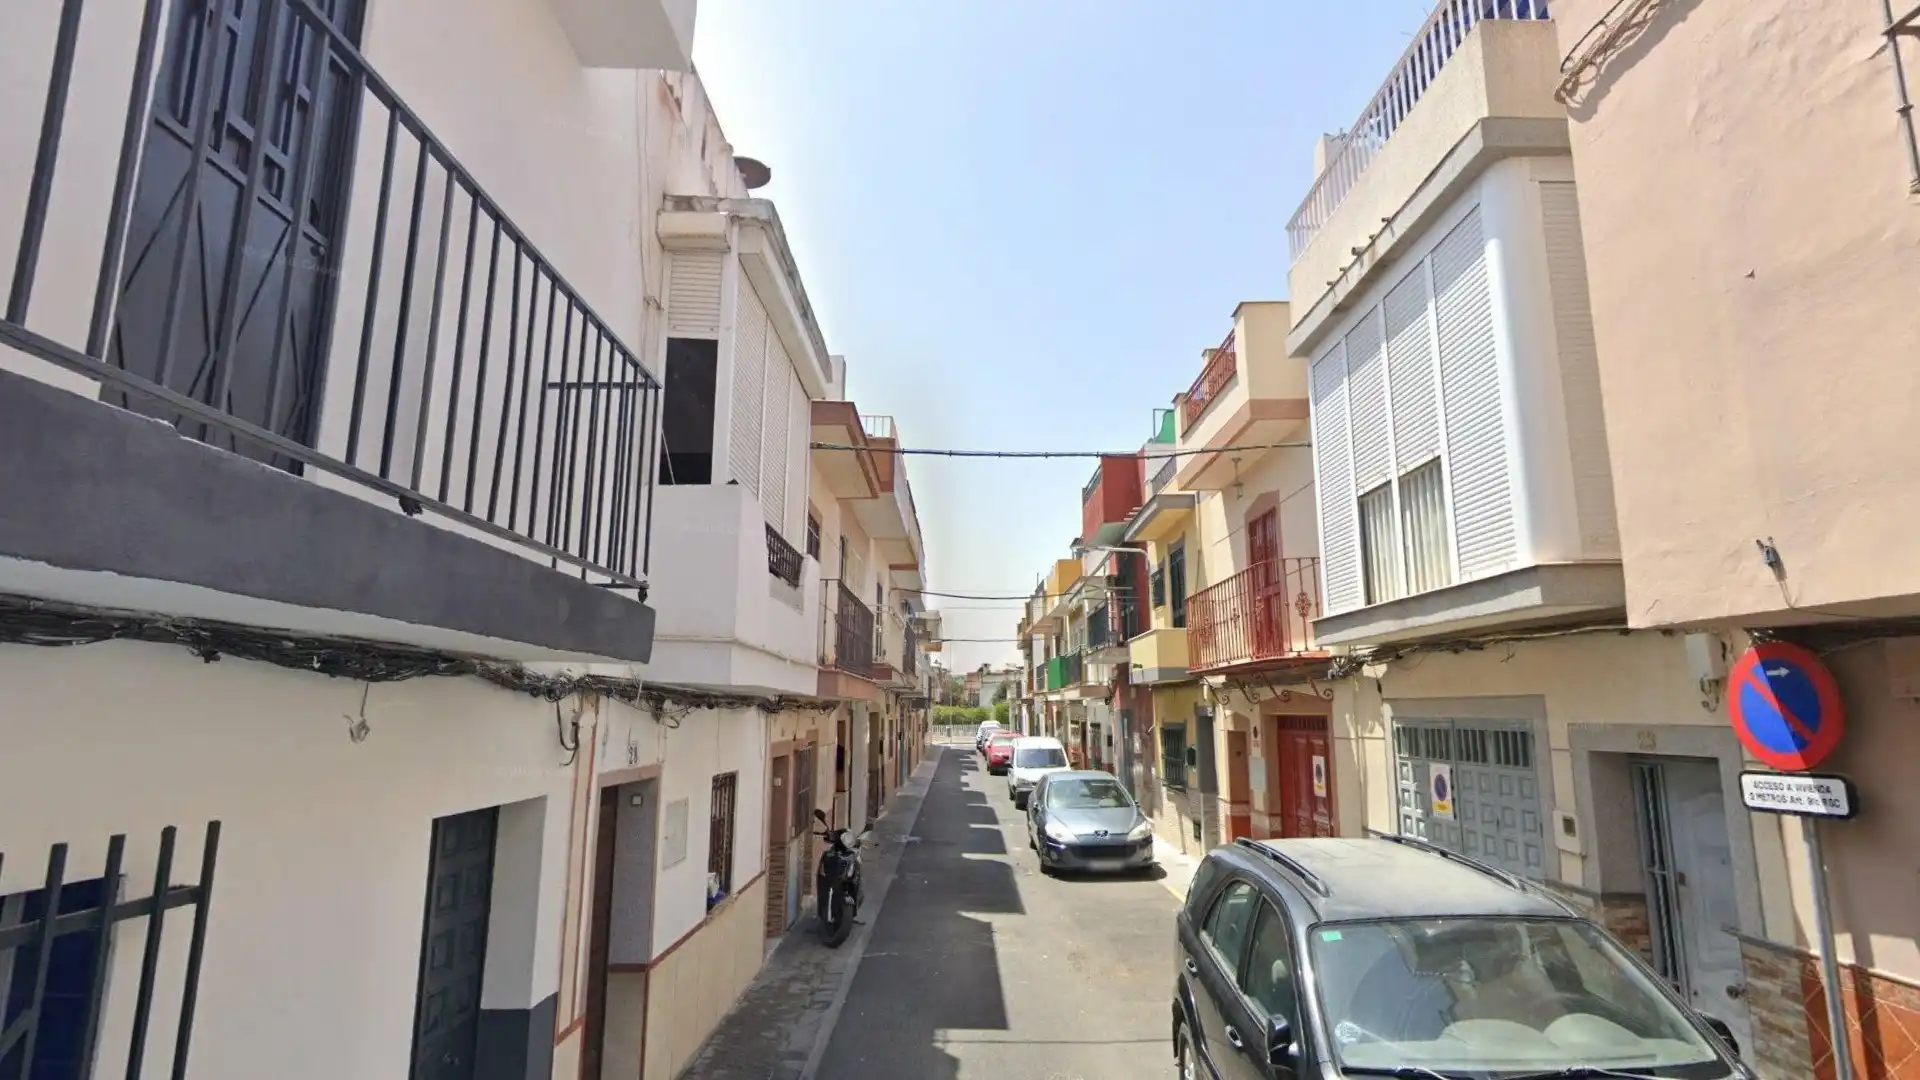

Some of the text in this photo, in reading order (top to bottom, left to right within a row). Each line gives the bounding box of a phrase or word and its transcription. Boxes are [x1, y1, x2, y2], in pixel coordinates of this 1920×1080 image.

[1753, 780, 1785, 791] ACCESO
[1795, 783, 1833, 794] VIVIENDA
[1755, 792, 1788, 804] METROS
